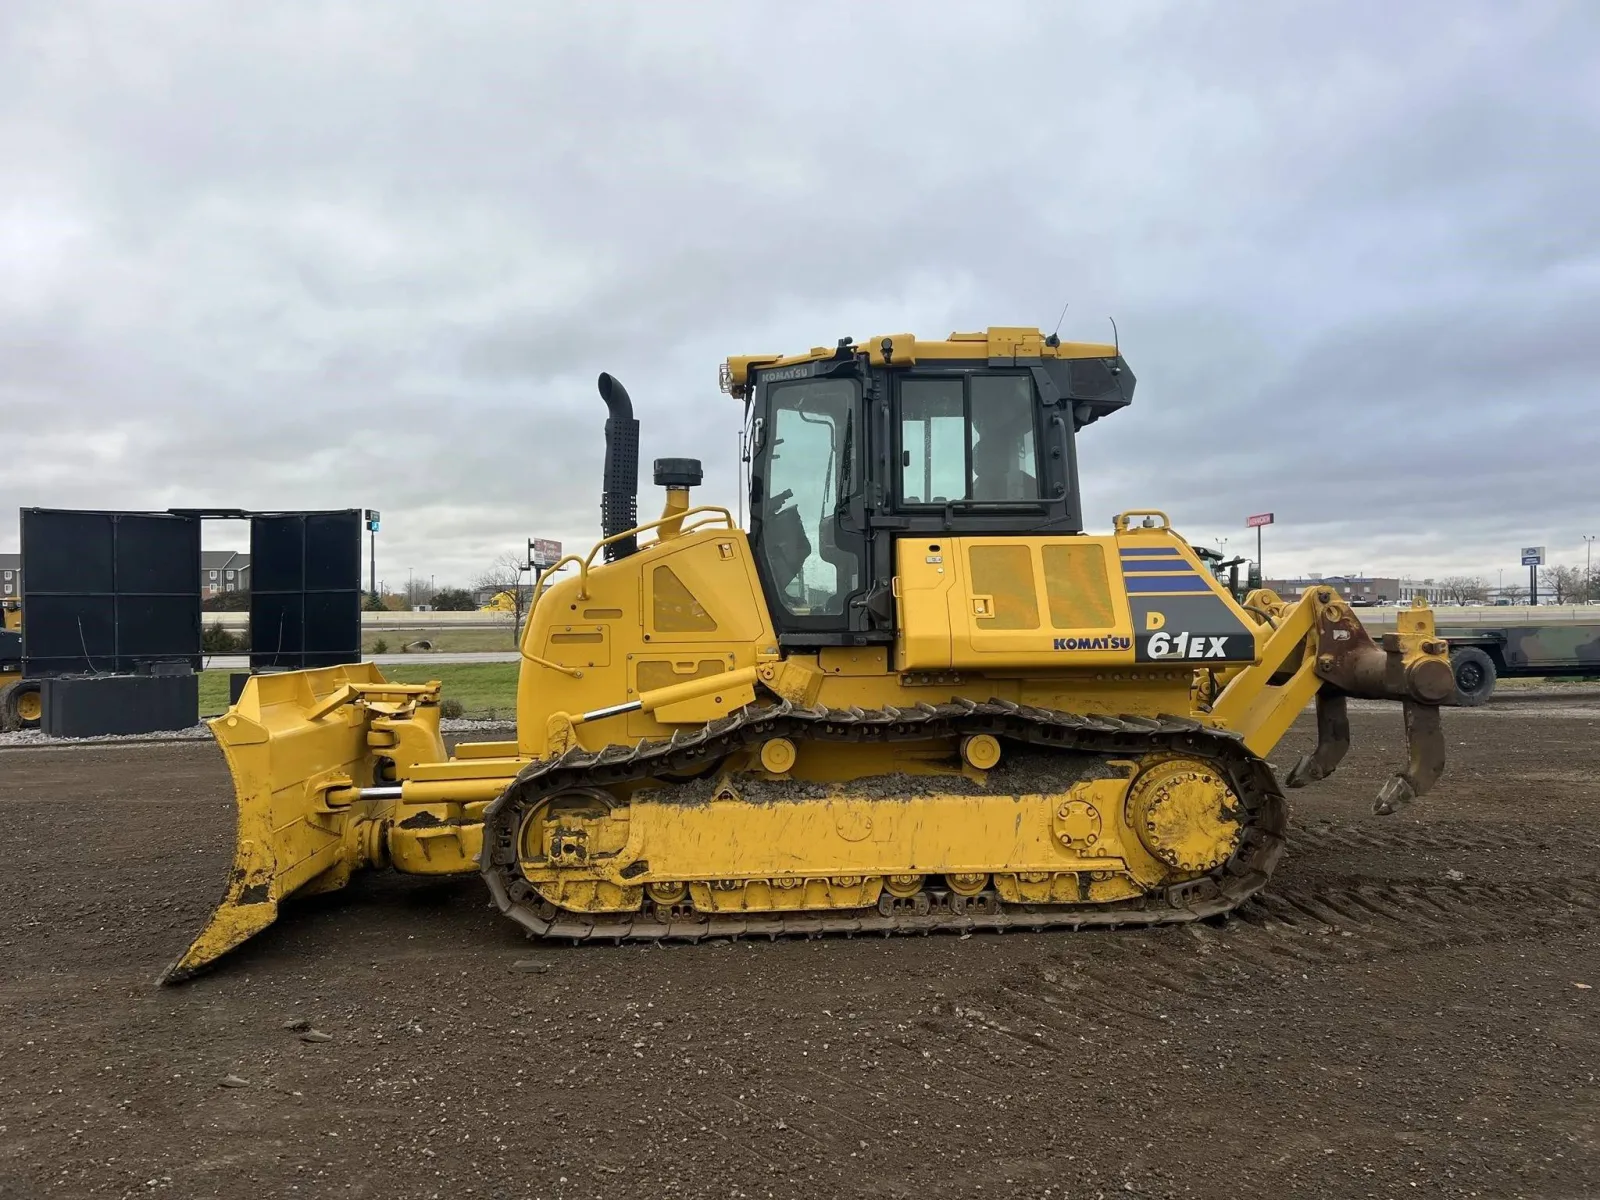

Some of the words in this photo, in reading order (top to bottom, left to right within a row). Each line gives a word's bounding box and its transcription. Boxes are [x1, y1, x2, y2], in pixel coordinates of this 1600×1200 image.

[762, 368, 808, 382] KOMATSU
[1146, 612, 1165, 630] D
[1053, 634, 1131, 650] KOMATSU
[1147, 631, 1229, 660] 61EX
